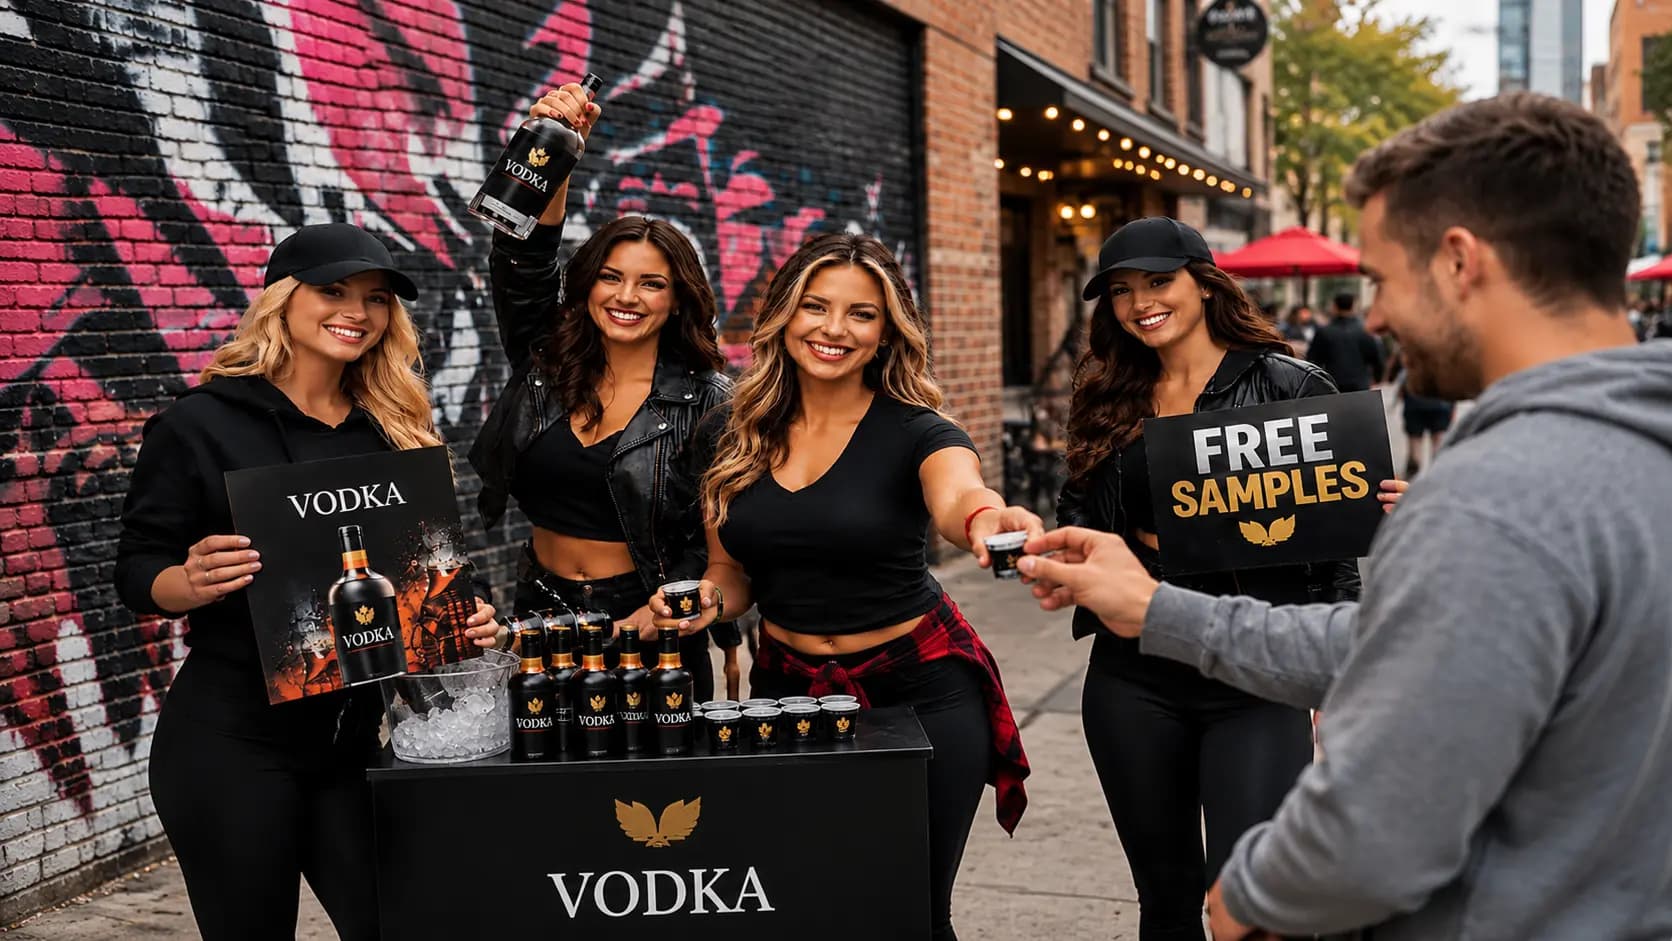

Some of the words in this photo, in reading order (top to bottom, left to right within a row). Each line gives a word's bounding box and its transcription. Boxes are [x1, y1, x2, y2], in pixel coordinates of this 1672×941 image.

[505, 159, 548, 193] VODKA
[1192, 413, 1333, 475] FREE
[287, 481, 407, 518] VODKA
[1171, 460, 1369, 518] SAMPLES
[342, 626, 395, 649] VODKA
[516, 717, 553, 728] VODKA
[578, 714, 615, 726] VODKA
[655, 712, 692, 724] VODKA
[547, 866, 776, 919] VODKA
